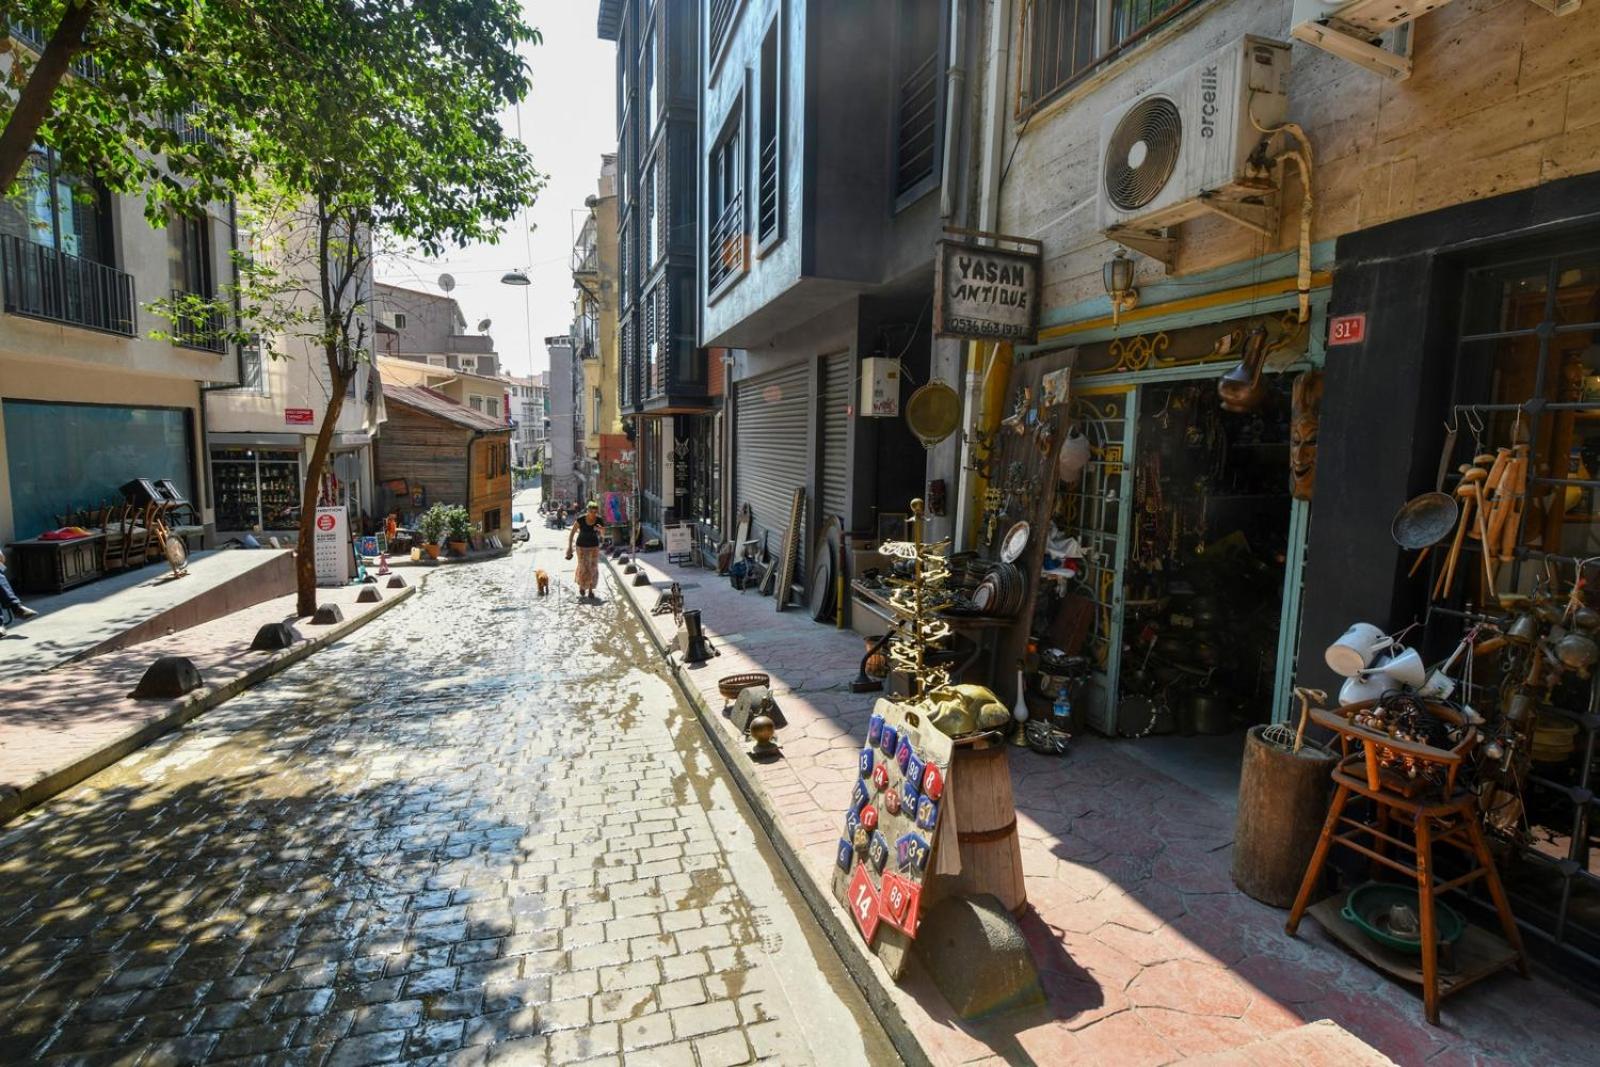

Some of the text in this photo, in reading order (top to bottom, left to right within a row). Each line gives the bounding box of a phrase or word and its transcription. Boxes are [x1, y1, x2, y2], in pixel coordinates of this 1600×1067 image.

[1201, 65, 1218, 138] arçelik
[951, 285, 1026, 309] ANTIQUE
[925, 771, 935, 789] 8
[863, 811, 874, 827] 17
[856, 883, 873, 921] 14
[890, 885, 903, 909] 88
